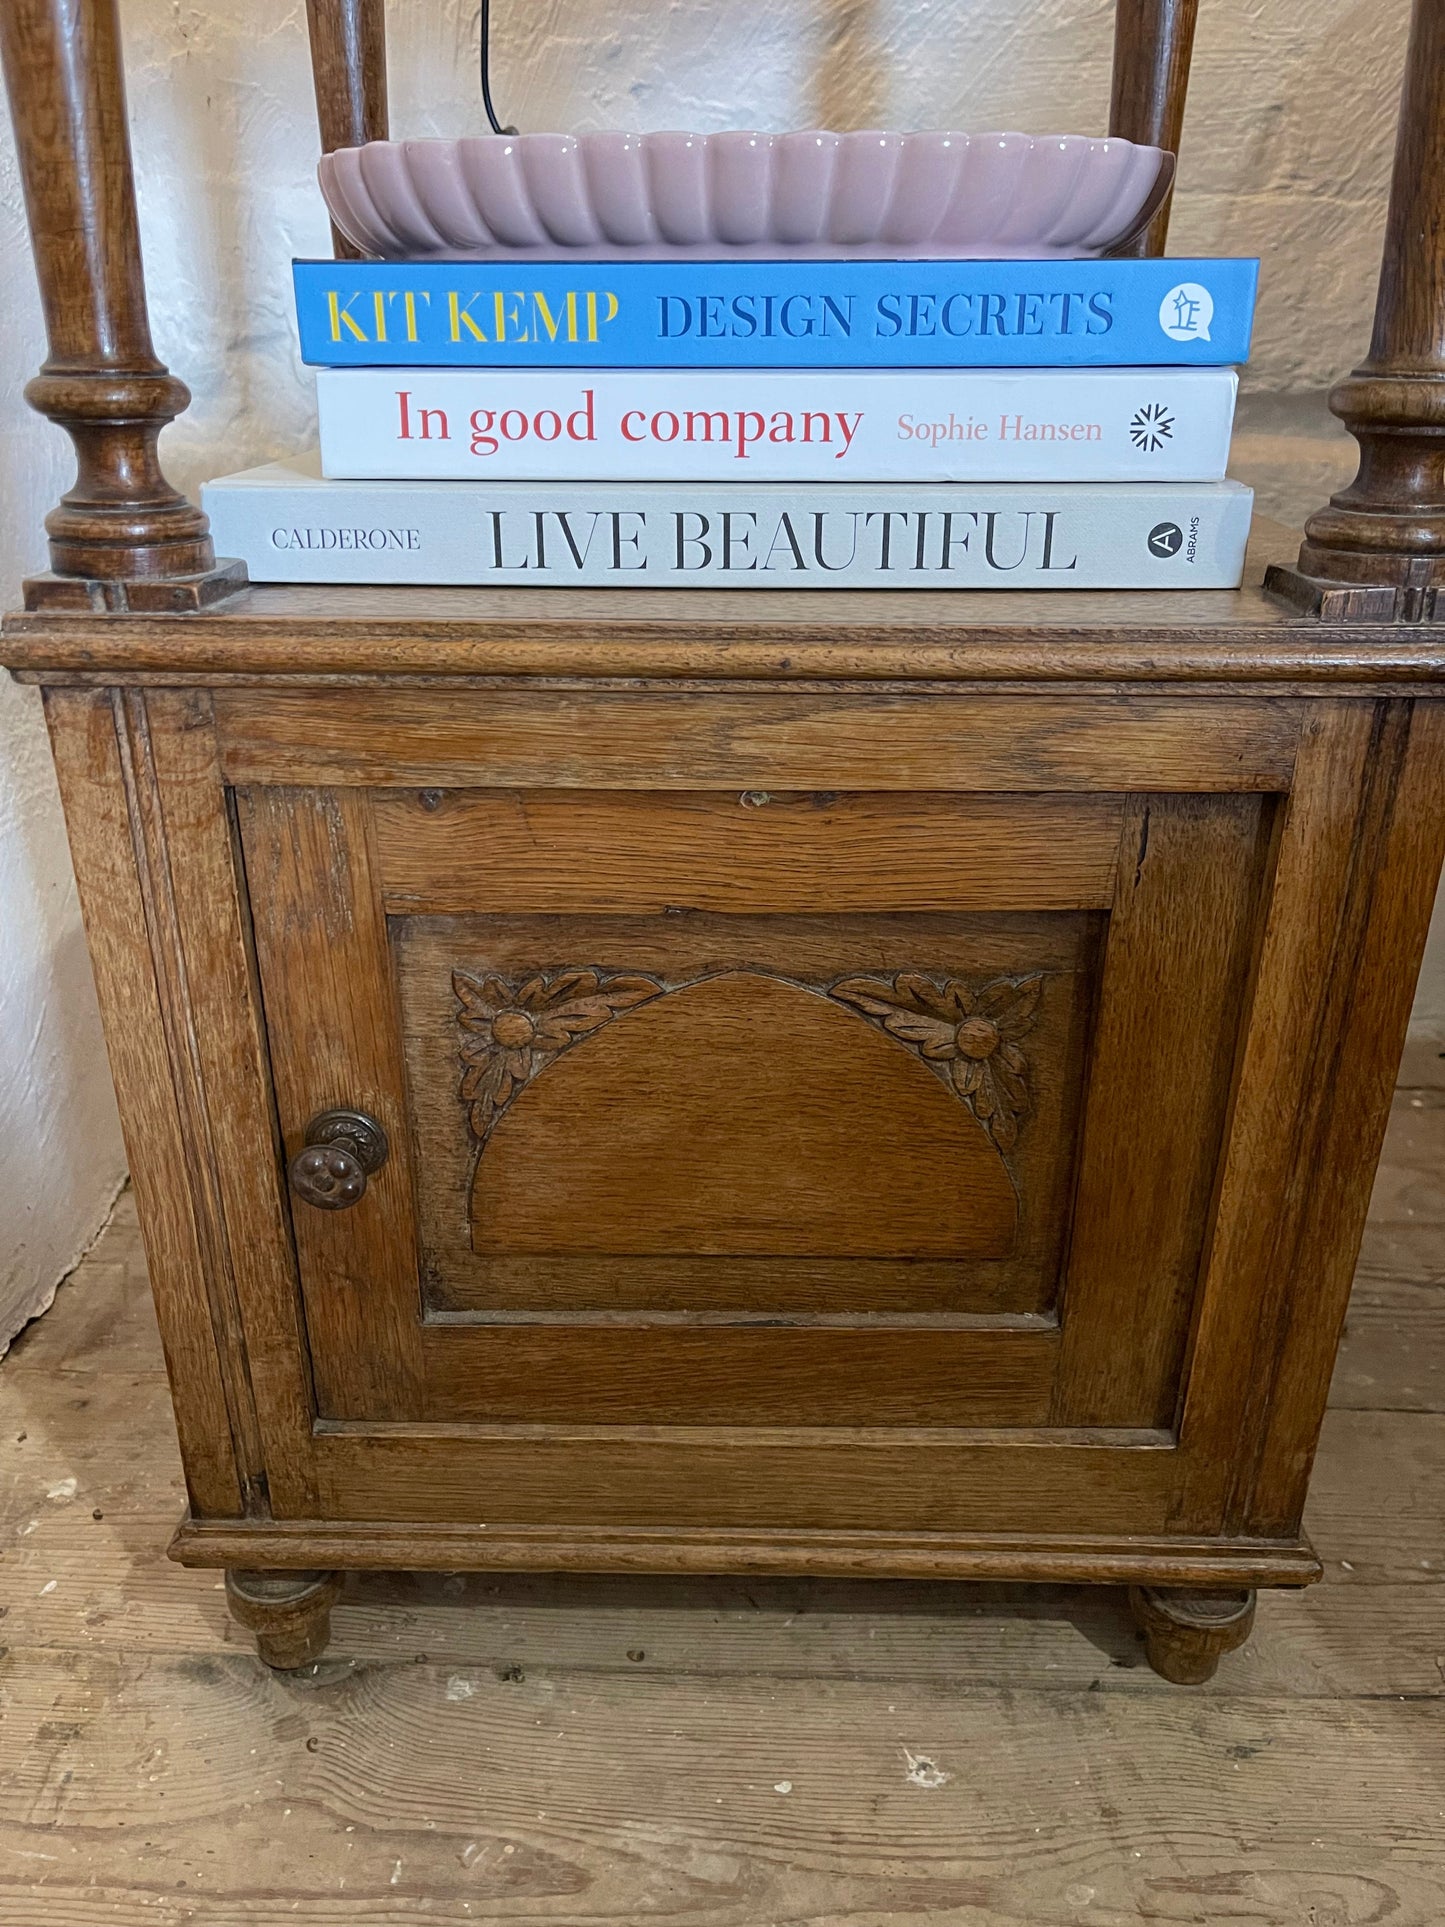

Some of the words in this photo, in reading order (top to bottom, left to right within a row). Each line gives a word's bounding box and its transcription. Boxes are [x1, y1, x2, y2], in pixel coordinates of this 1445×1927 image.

[327, 291, 430, 343] KIT
[447, 291, 619, 343] KEMP
[656, 295, 857, 338] DESIGN
[875, 291, 1114, 338] SECRETS
[394, 391, 452, 440] In
[469, 390, 599, 456] good
[620, 411, 865, 458] company
[897, 414, 989, 448] Sophie
[998, 416, 1103, 441] Hansen
[271, 528, 421, 550] CALDERONE
[485, 511, 647, 570] LIVE
[670, 511, 1078, 571] BEAUTIFUL
[1186, 516, 1200, 563] ABRAMS
